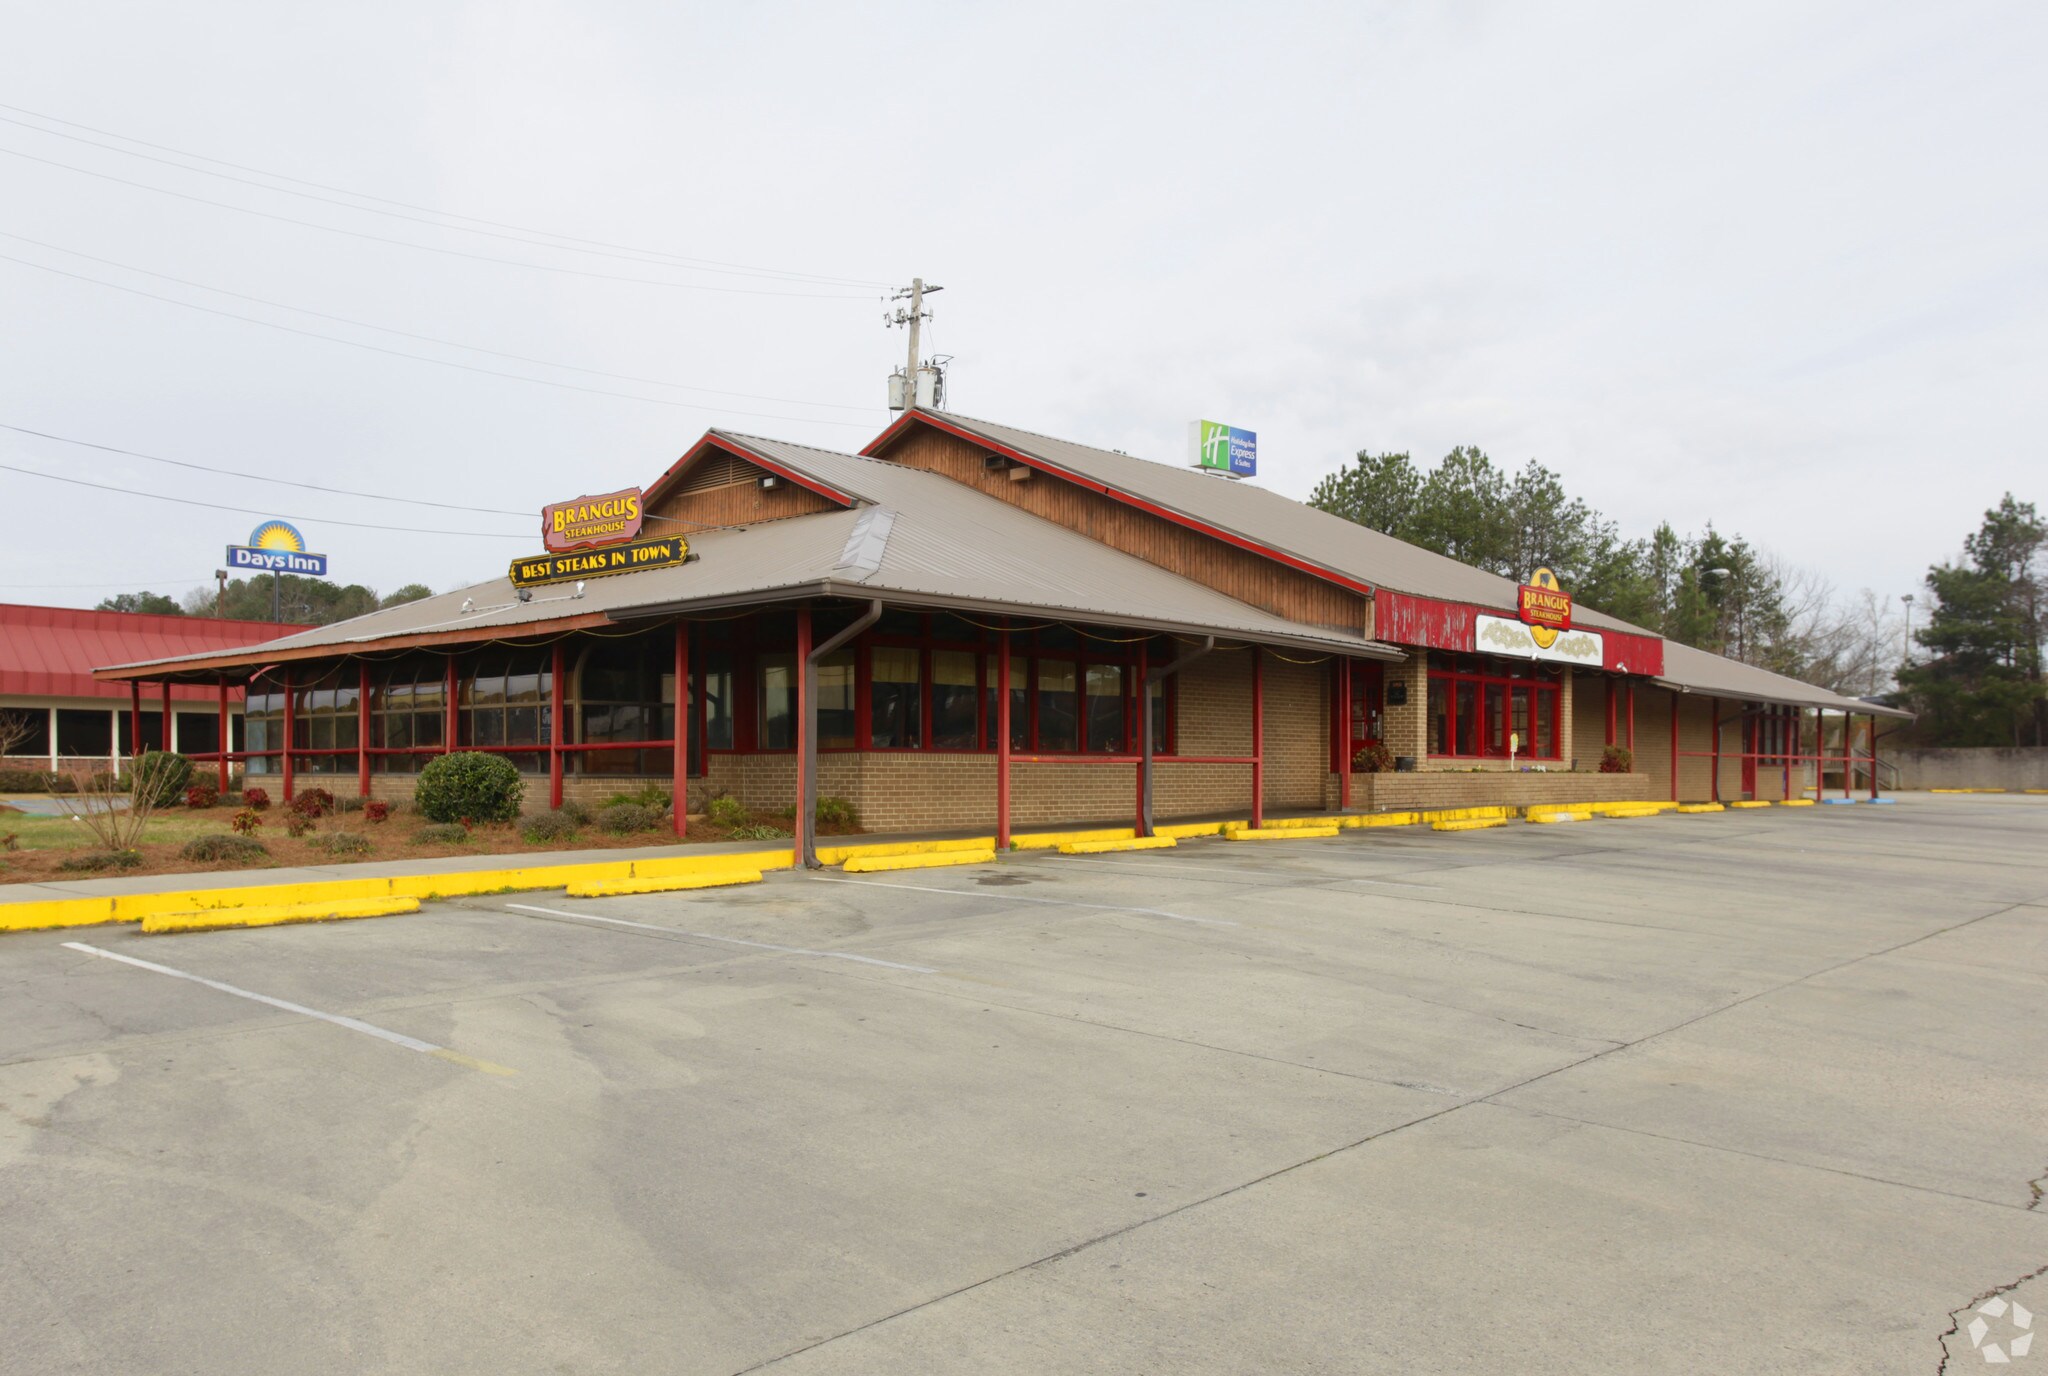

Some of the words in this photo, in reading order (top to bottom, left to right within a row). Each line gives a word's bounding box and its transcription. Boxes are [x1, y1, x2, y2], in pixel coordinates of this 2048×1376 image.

[1230, 445, 1255, 460] Express
[553, 497, 639, 532] BRANGUS
[565, 520, 625, 540] STEAKHOUSE
[236, 549, 286, 569] Days
[288, 554, 320, 572] Inn
[522, 562, 551, 578] BEST
[557, 554, 606, 574] STEAKS
[612, 551, 626, 566] IN
[632, 544, 671, 562] TOWN
[1523, 591, 1569, 616] BRANGUS
[1530, 609, 1563, 622] STEAKHOUSE
